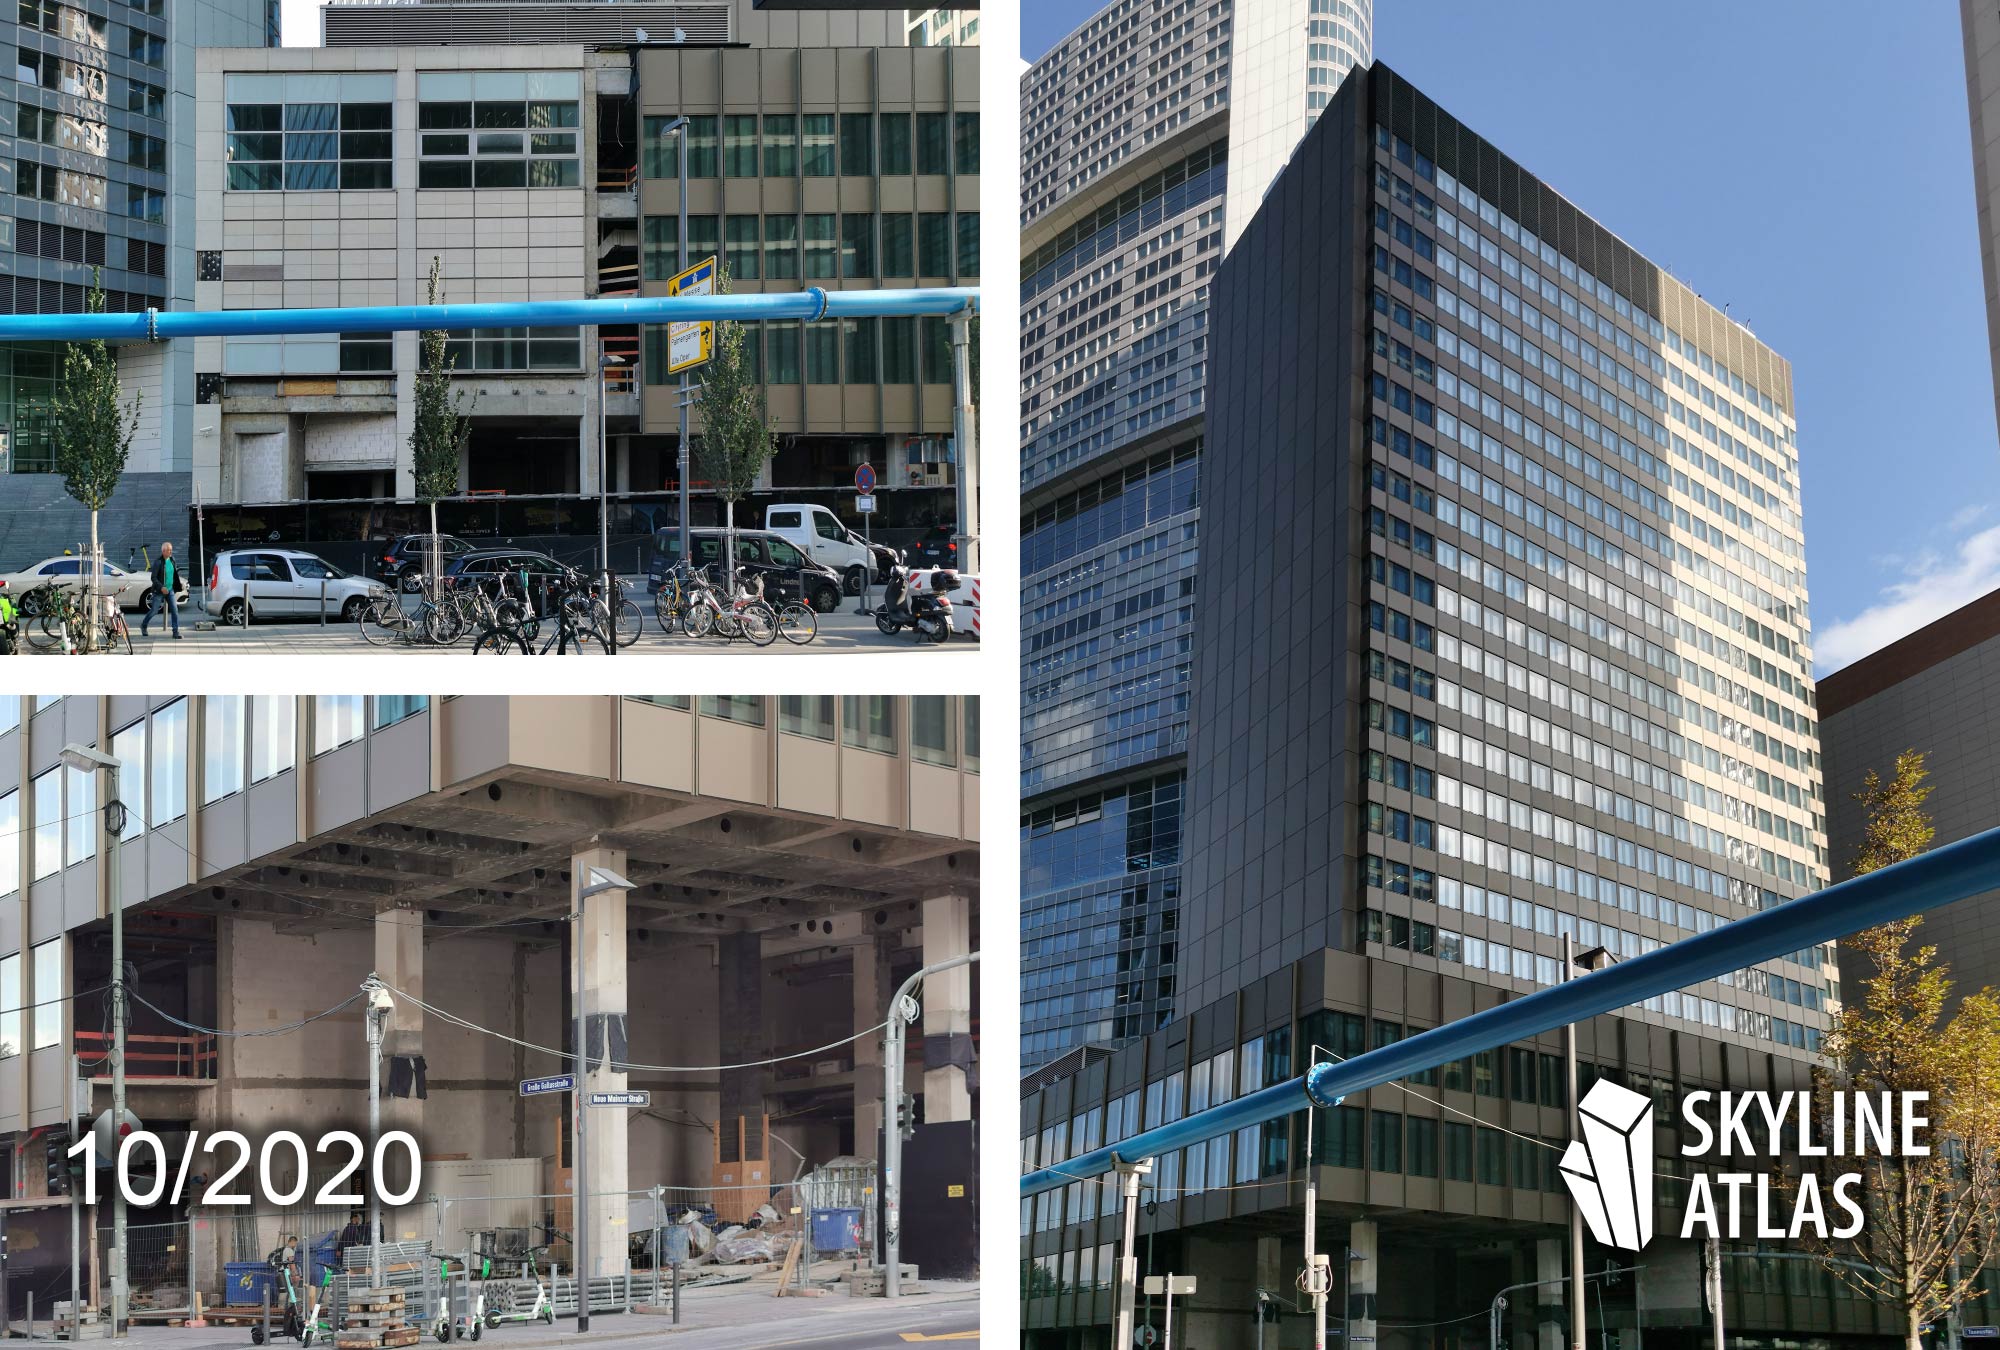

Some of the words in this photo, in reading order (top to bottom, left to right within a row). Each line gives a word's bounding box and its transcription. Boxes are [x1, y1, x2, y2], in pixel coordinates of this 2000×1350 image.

[527, 1082, 541, 1092] Große
[541, 1079, 569, 1091] Gallusstraße
[593, 1094, 607, 1104] Neue
[607, 1094, 628, 1104] Mainzer
[628, 1094, 644, 1104] Straße
